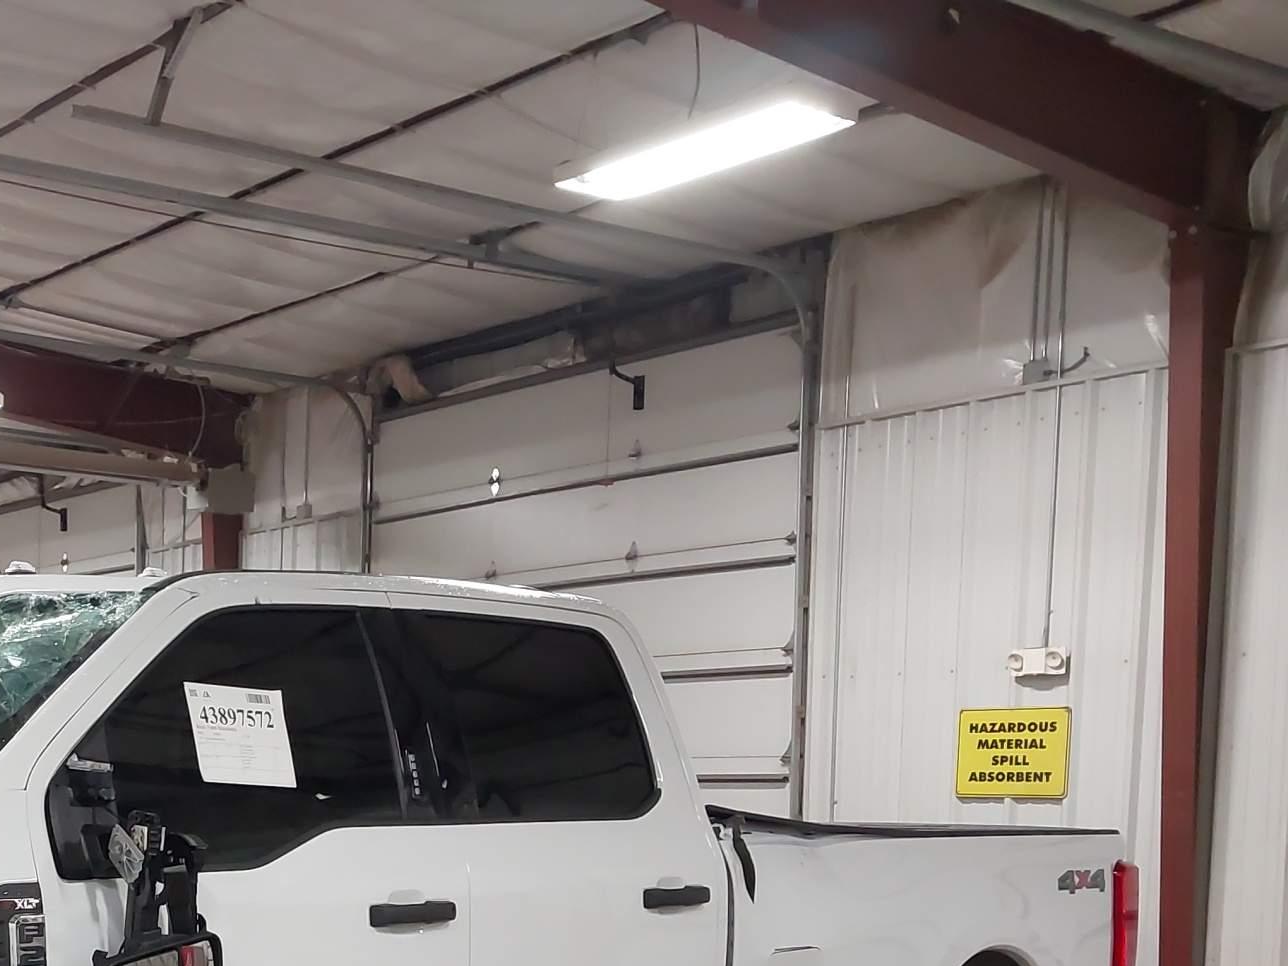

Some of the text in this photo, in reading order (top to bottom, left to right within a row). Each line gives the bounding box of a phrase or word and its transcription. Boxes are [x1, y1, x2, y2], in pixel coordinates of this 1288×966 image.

[200, 706, 274, 729] 43897572
[969, 721, 1058, 733] HAZARDOUS
[977, 739, 1047, 749] MATERIAL
[992, 755, 1030, 766] SPILL
[968, 772, 1053, 782] ABSORBENT
[14, 898, 40, 910] XLT
